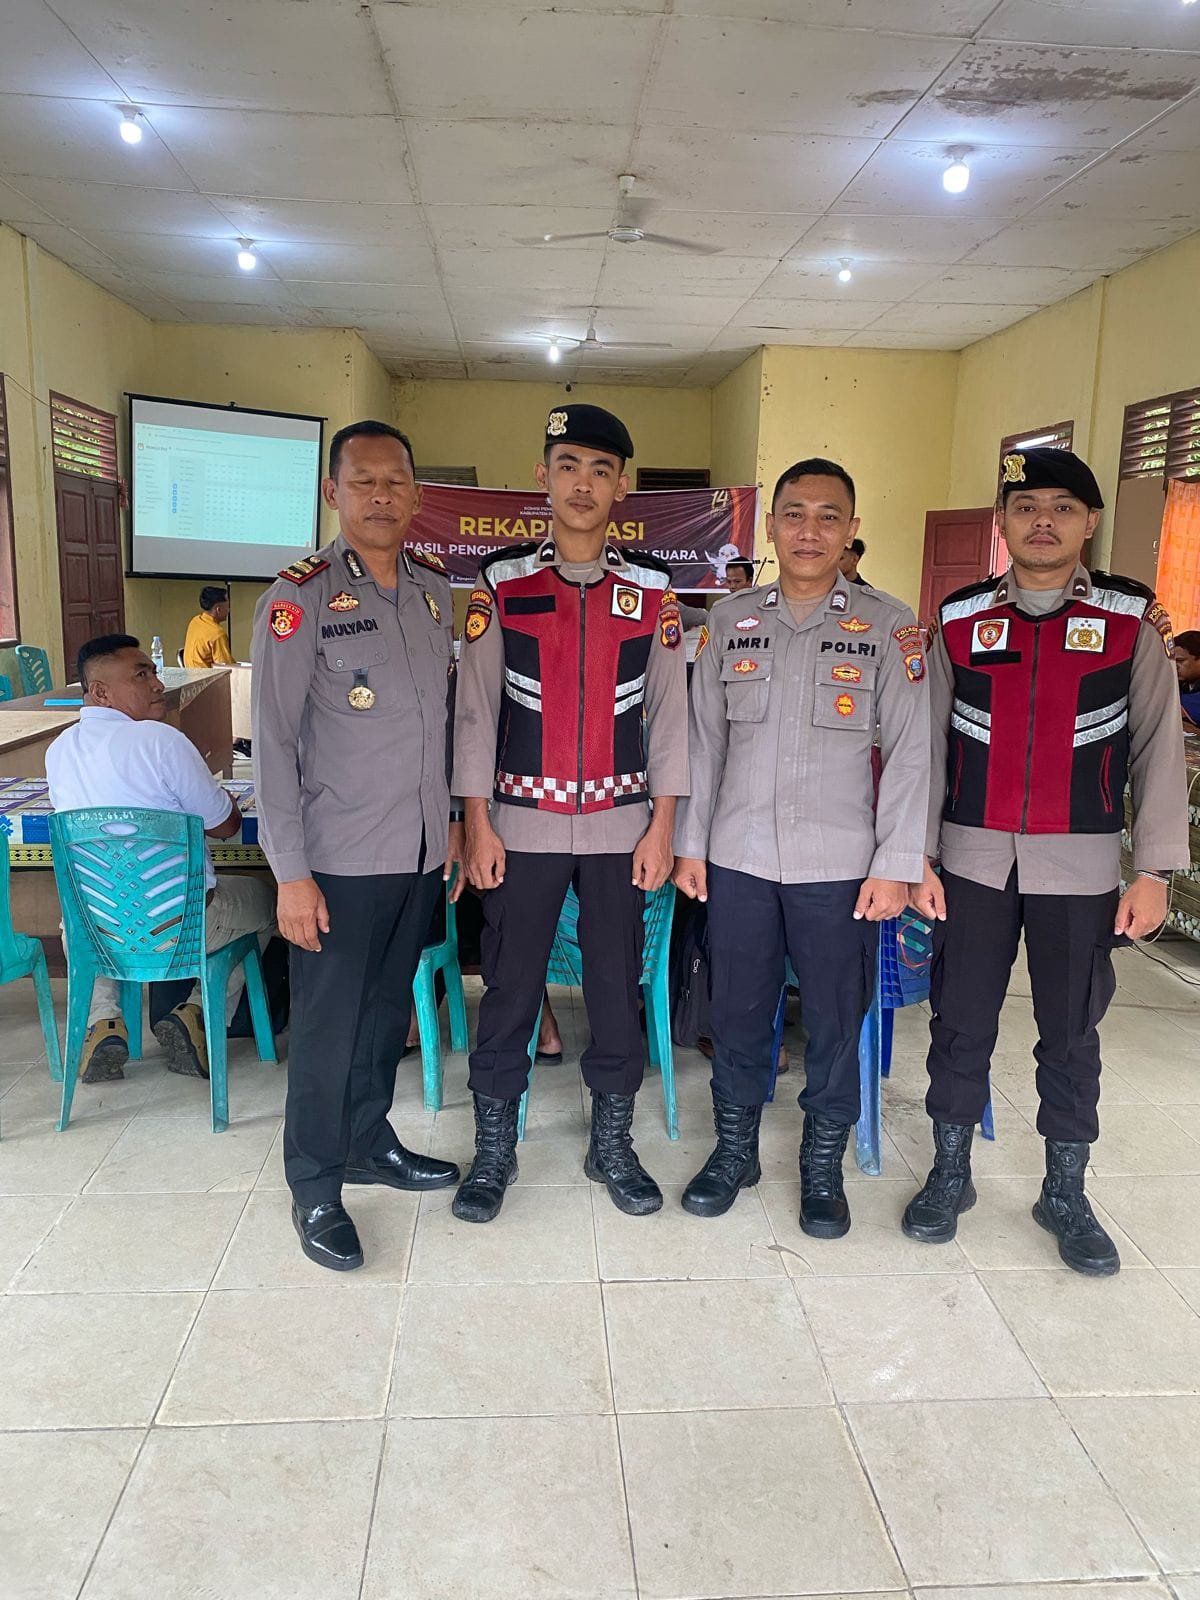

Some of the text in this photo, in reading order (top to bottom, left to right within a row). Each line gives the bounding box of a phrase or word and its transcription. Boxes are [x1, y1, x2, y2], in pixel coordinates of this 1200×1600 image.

[711, 490, 728, 509] 14
[403, 541, 445, 554] HASIL
[651, 549, 699, 561] SUARA
[321, 618, 379, 639] MULYADI
[727, 637, 770, 651] AMRI
[820, 641, 877, 657] POLRI
